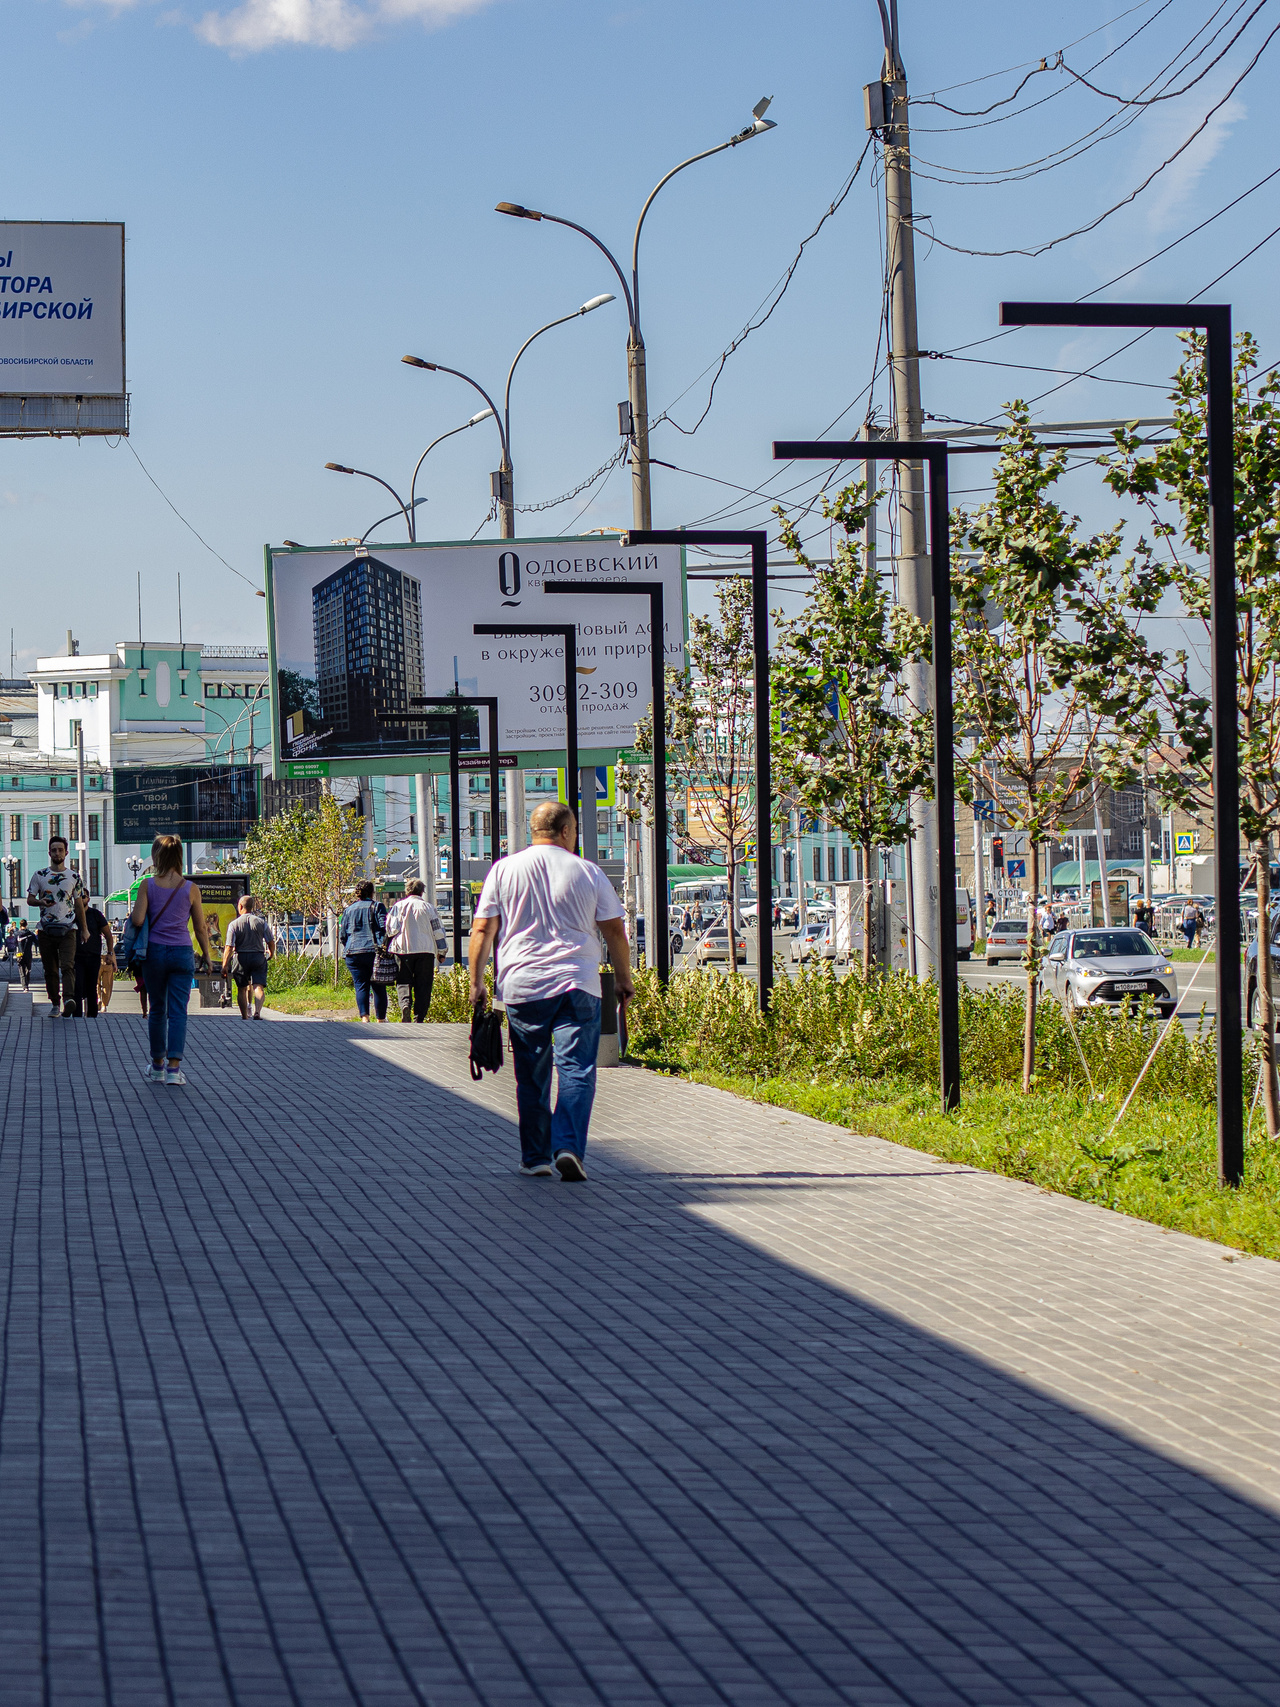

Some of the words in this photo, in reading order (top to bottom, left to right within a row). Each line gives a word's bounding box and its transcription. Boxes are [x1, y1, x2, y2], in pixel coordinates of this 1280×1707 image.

[60, 358, 93, 366] ОБЛАСТИ
[481, 650, 490, 661] в
[497, 646, 596, 663] окружеии
[528, 681, 638, 702] 3092-309
[581, 702, 629, 714] продаж
[458, 758, 514, 766] изайнмтер.
[143, 793, 168, 801] ТВОЙ
[132, 803, 179, 811] СПОРТЗАЛ
[997, 889, 1019, 897] СТОП
